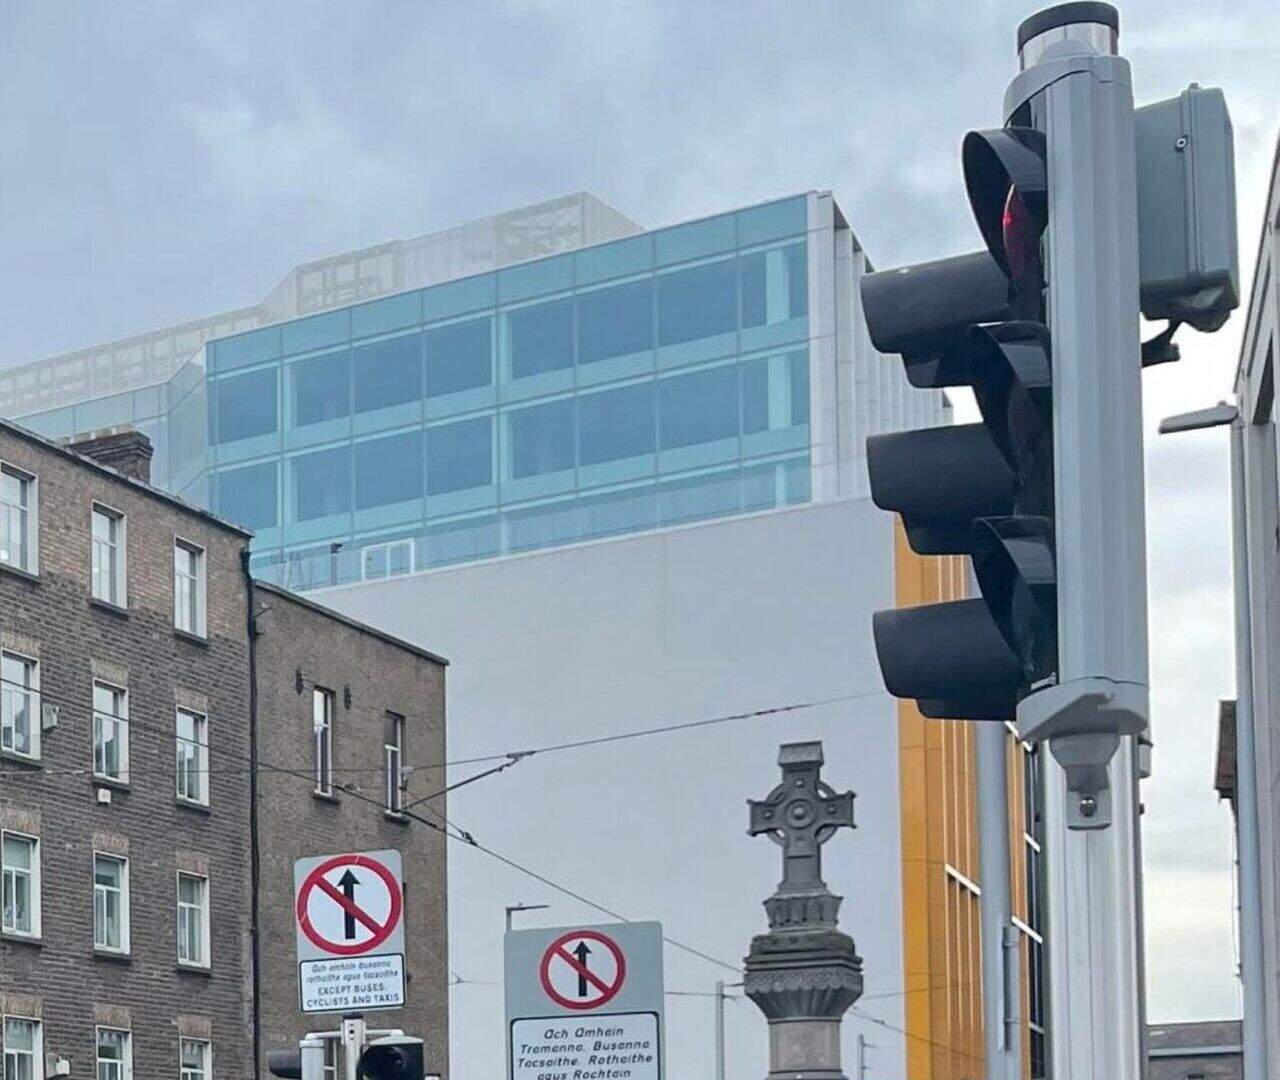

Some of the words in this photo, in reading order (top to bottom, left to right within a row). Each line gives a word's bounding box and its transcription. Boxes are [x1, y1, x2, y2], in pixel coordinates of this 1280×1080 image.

[318, 986, 351, 995] EXCEPT
[307, 998, 349, 1007] CYCLISTS
[353, 996, 371, 1004] AND
[375, 993, 399, 1001] TAXIS
[573, 1069, 631, 1080] Rochtain
